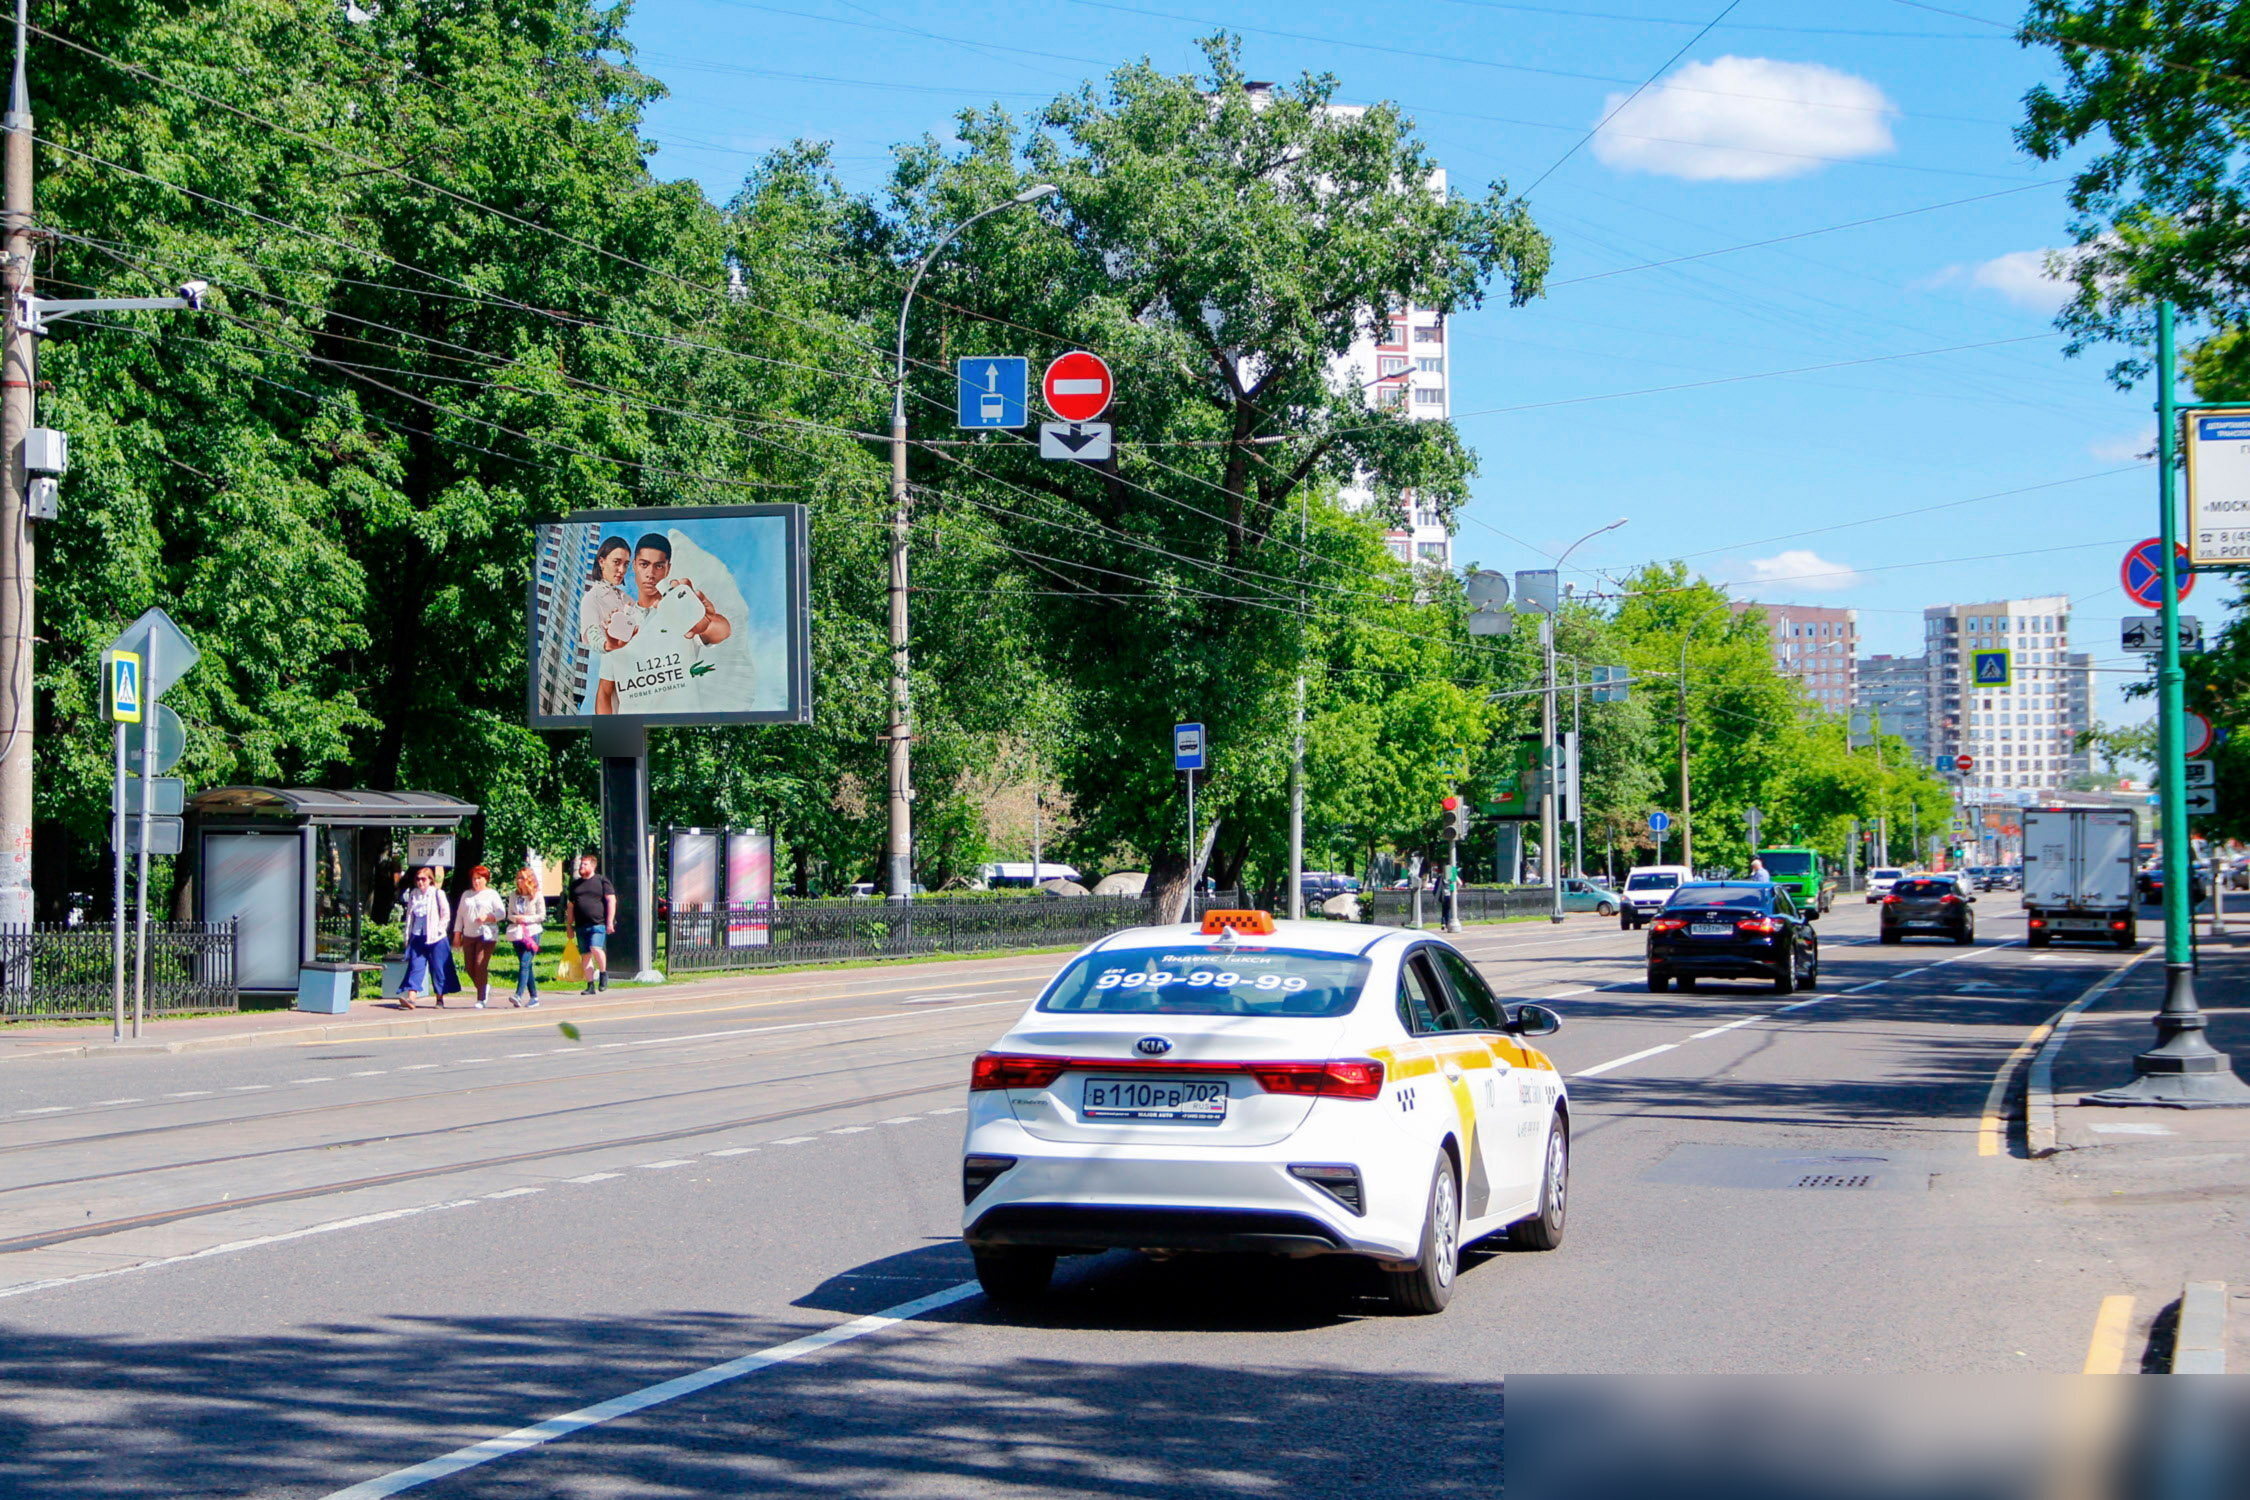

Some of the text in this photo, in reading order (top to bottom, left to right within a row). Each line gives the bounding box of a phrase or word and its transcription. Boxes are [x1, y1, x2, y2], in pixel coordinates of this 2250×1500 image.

[636, 653, 681, 673] L.12.12
[617, 668, 684, 693] LACOSTE
[629, 682, 686, 699] НОВЫЕ АРОМАТЫ
[1161, 954, 1272, 965] Яндекс Такси
[1095, 971, 1308, 993] 999-99-99
[1140, 1040, 1166, 1053] KIA
[1092, 1083, 1220, 1108] В110РВ 702
[1192, 1102, 1210, 1110] RUS
